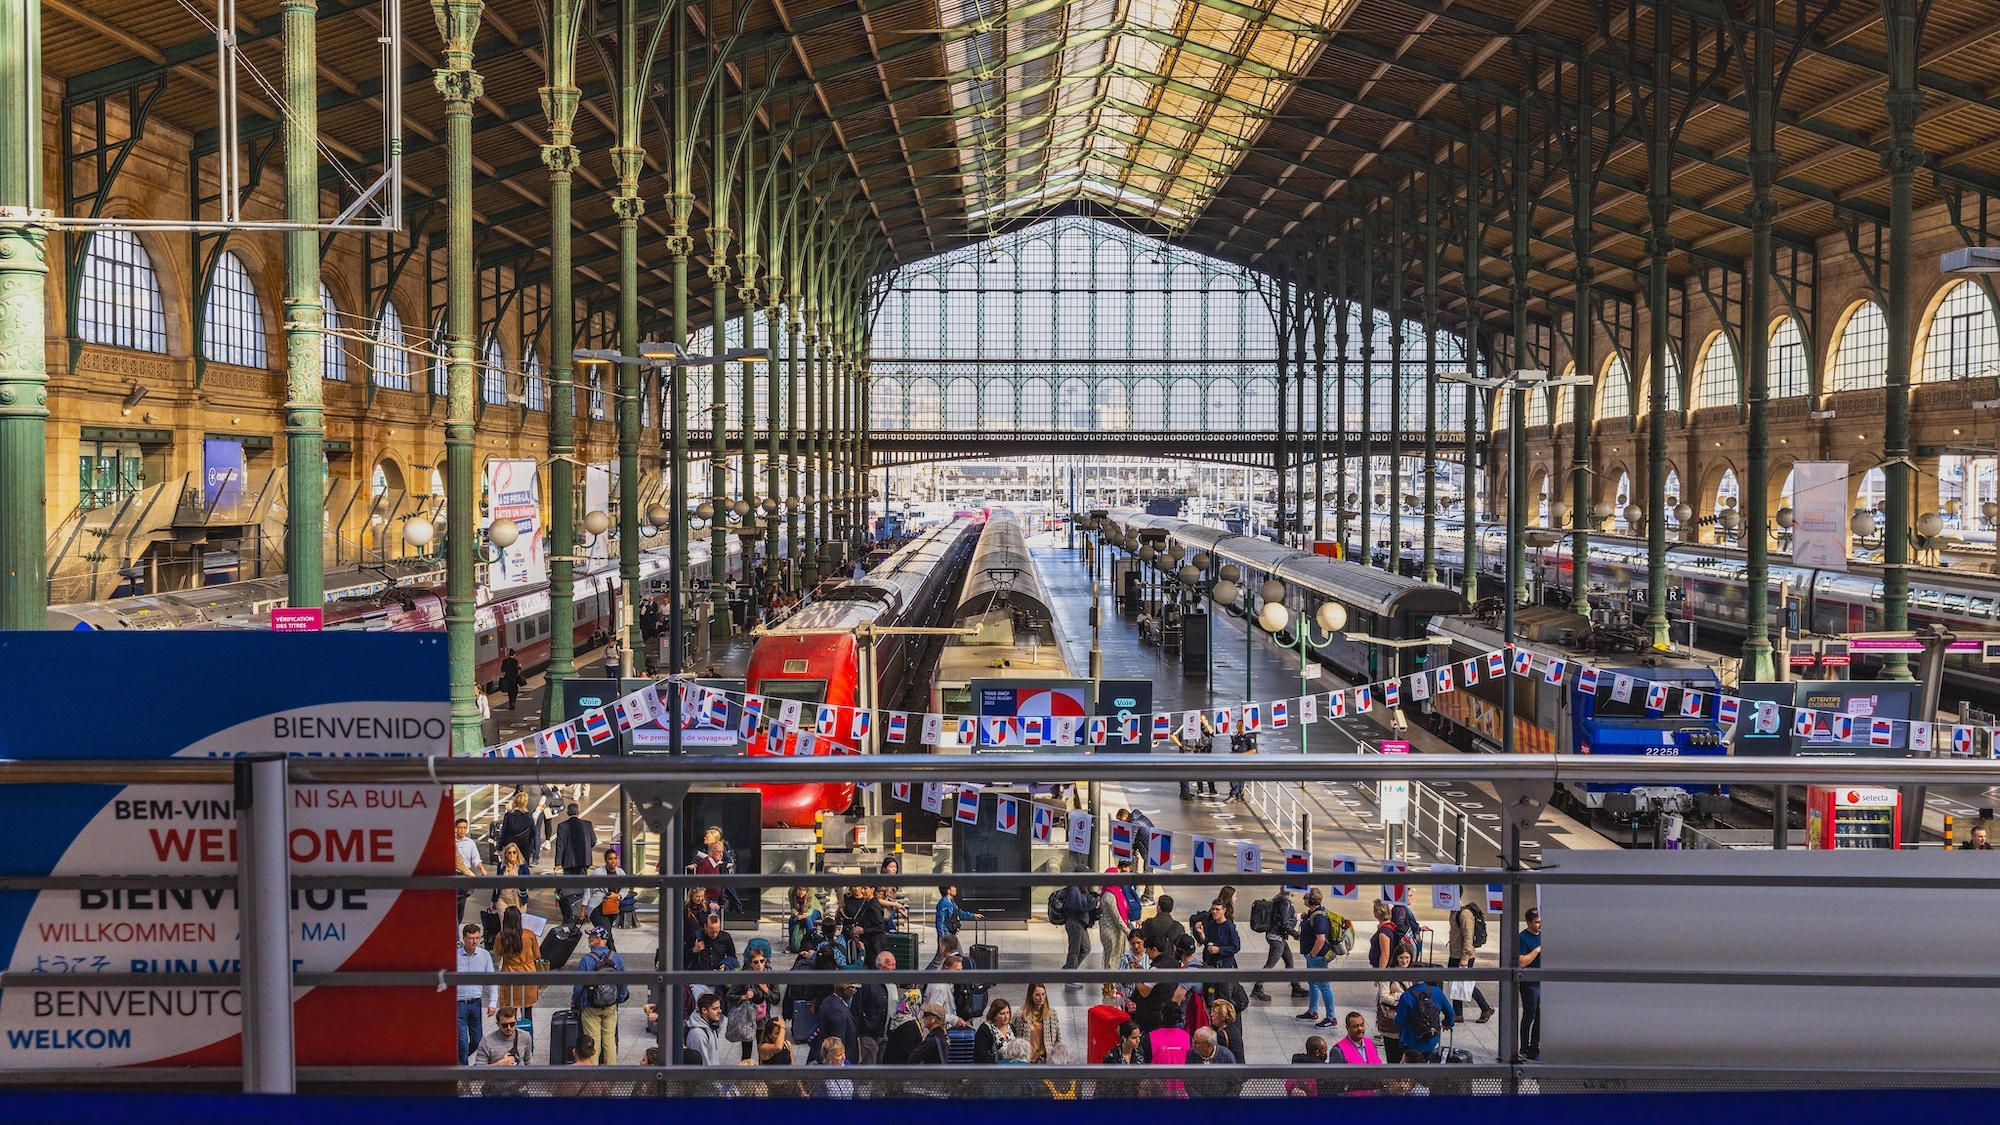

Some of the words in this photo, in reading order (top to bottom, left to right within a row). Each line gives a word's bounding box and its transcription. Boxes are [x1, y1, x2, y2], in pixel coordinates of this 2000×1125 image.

[1637, 592, 1644, 601] R
[1670, 592, 1677, 600] R
[1788, 611, 1798, 630] 10
[274, 718, 445, 739] BIENVENIDO
[296, 790, 318, 808] NI
[327, 790, 359, 808] SA
[366, 790, 427, 808] BULA
[149, 828, 394, 863] WEOME
[39, 923, 216, 942] WILLKOMMEN
[302, 922, 346, 941] MAI
[8, 1029, 132, 1049] WELKOM
